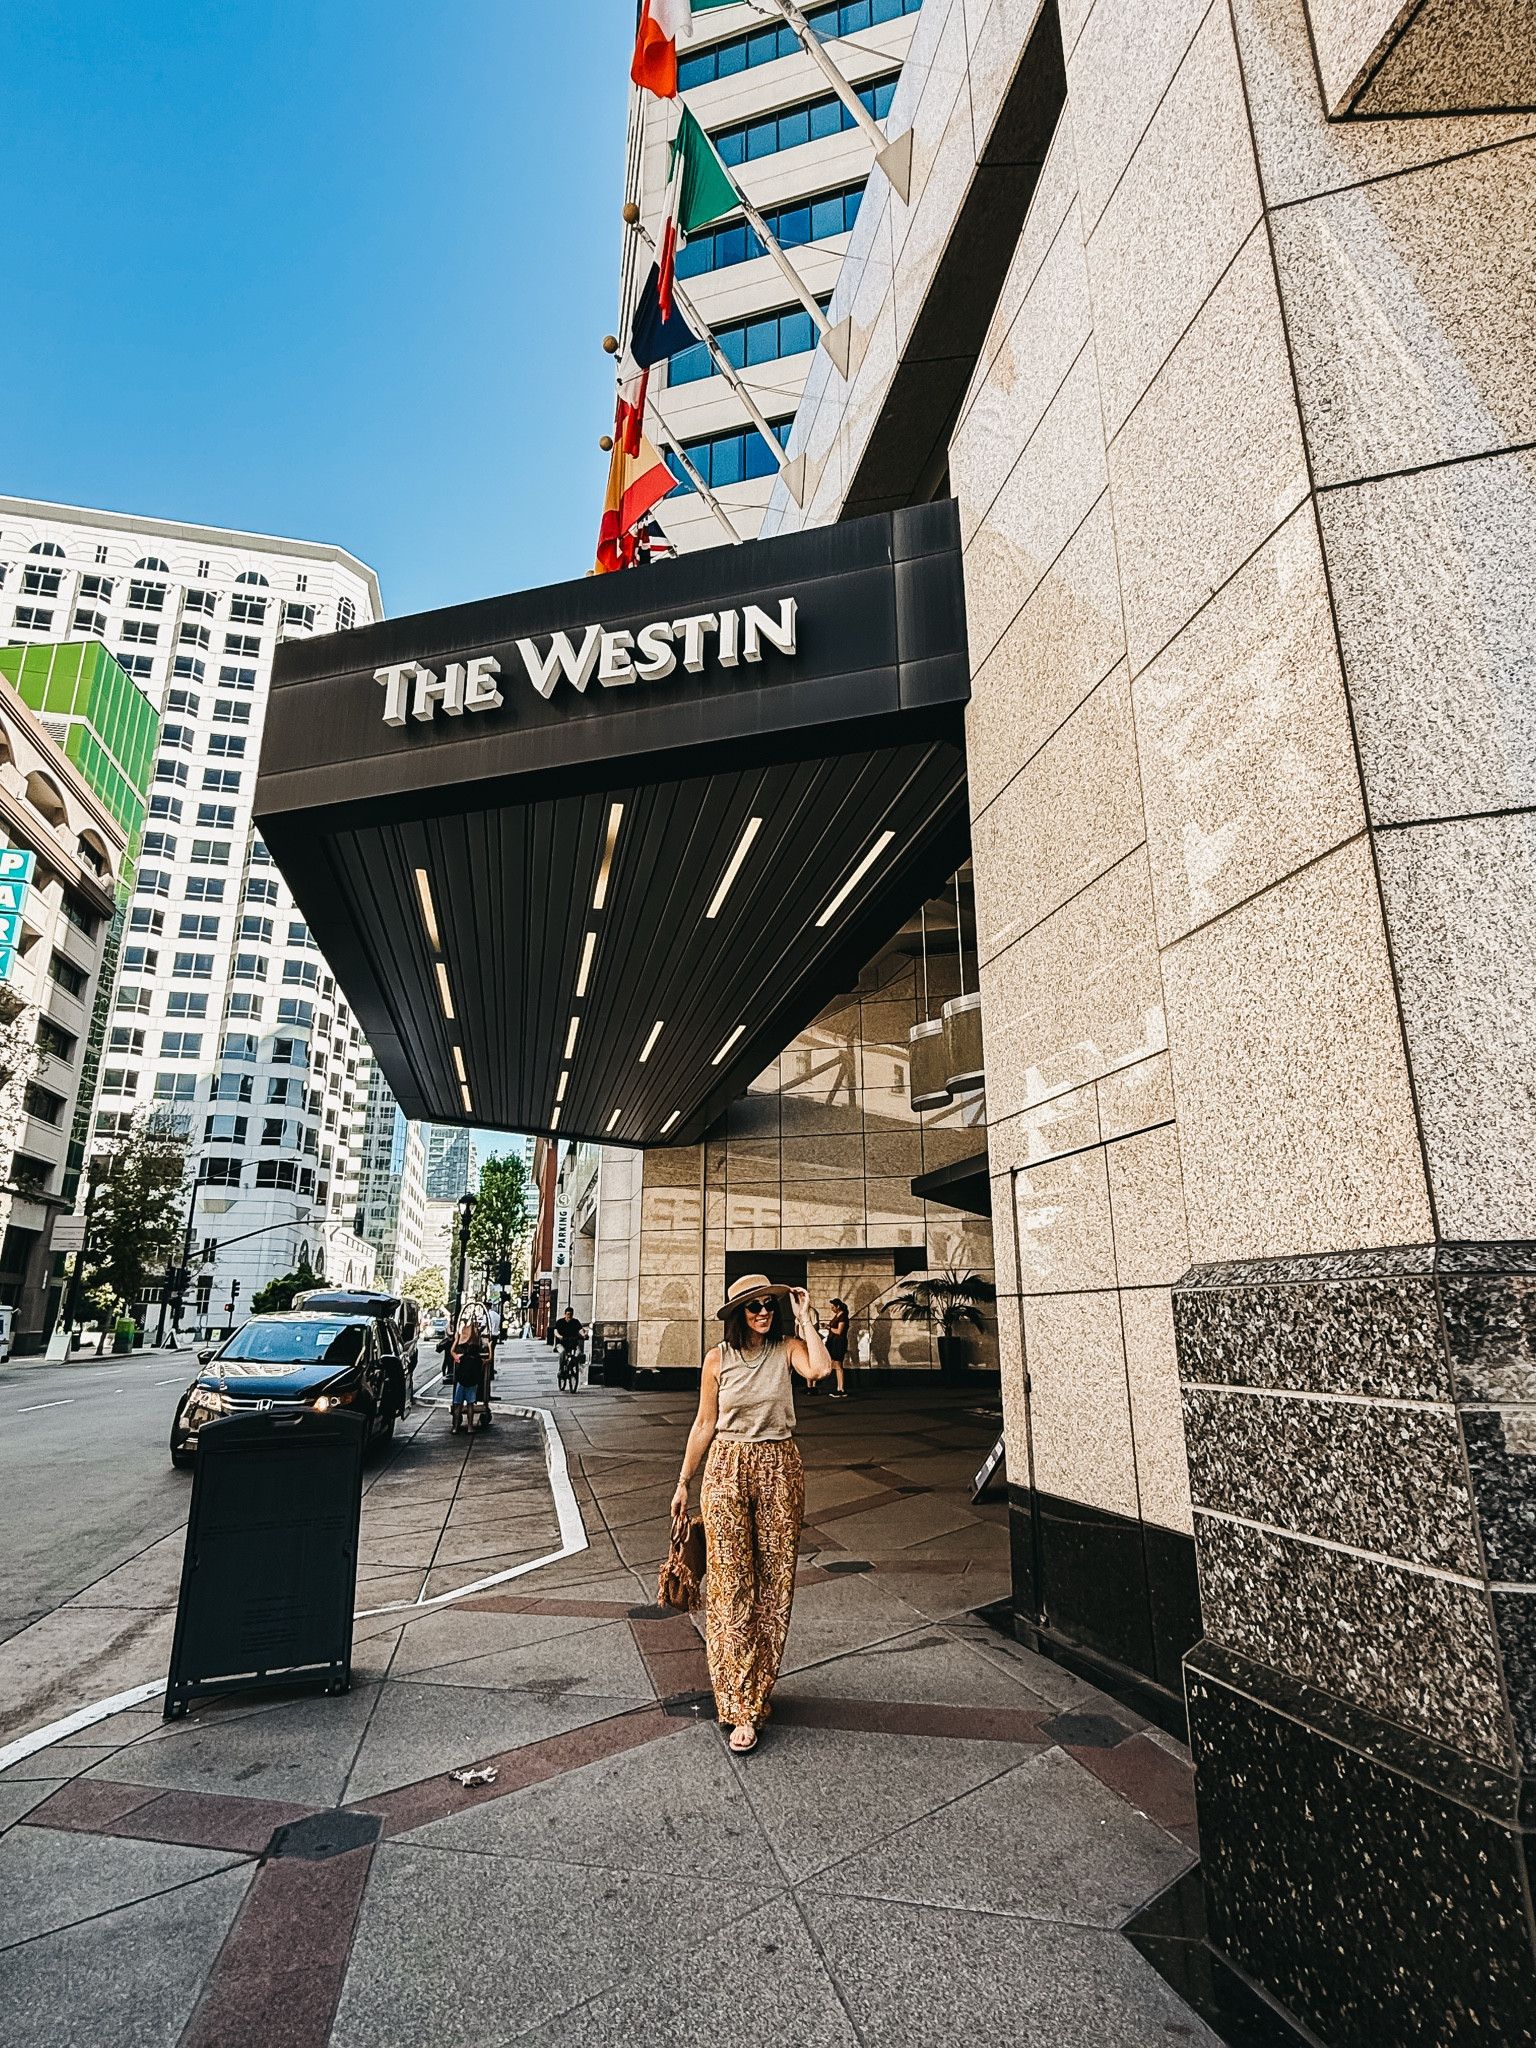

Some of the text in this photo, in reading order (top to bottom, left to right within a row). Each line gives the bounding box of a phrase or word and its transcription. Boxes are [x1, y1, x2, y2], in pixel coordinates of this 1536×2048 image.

[373, 597, 798, 727] THE WESTIN
[0, 853, 24, 974] PA
[558, 1210, 568, 1249] PARKING
